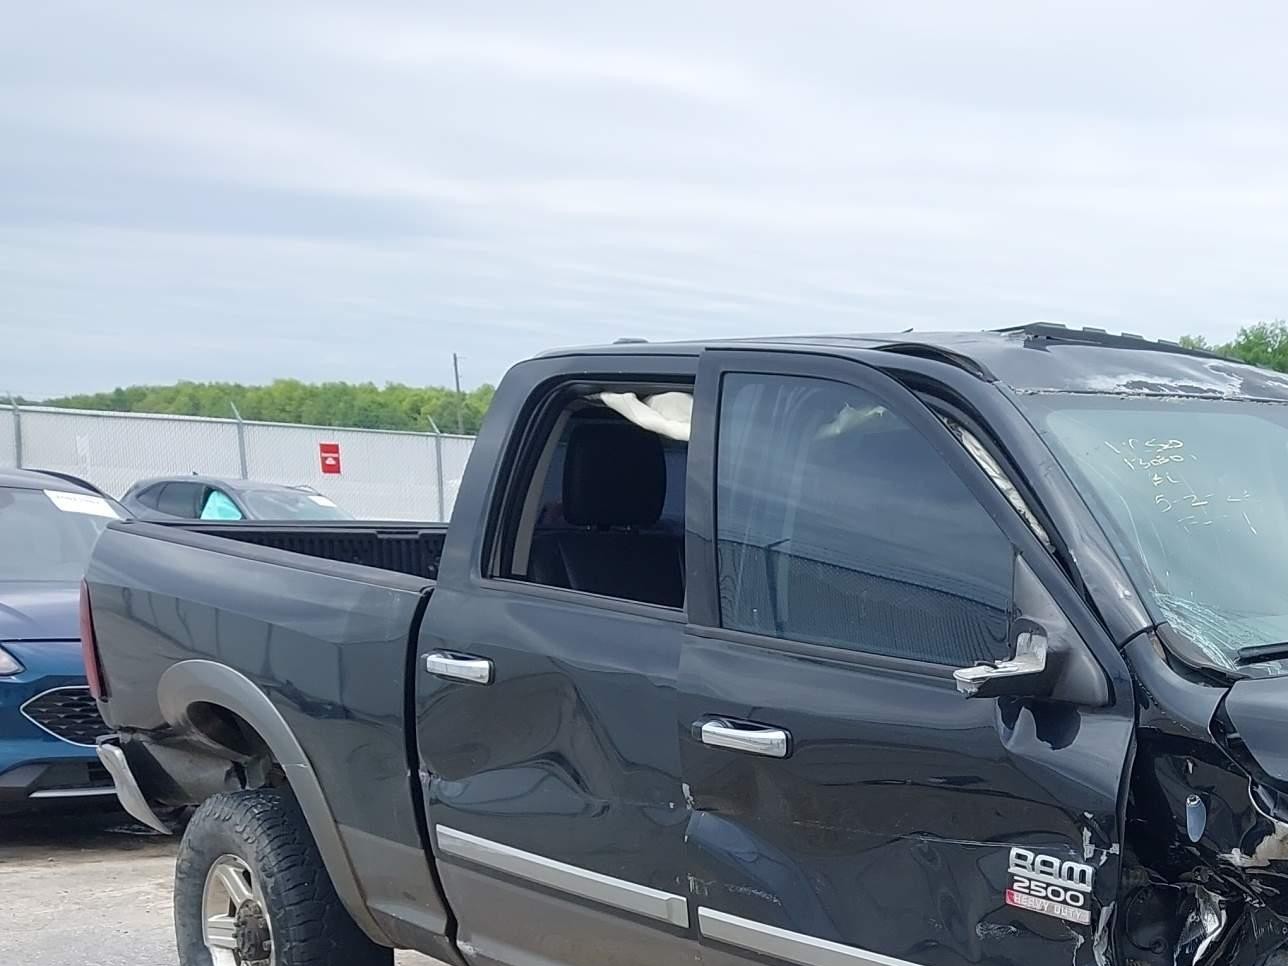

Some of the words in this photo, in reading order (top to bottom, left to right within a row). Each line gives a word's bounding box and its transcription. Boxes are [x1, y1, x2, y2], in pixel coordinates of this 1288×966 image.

[1009, 847, 1093, 889] RAM
[1013, 876, 1084, 907] 2500
[1014, 893, 1049, 912] HEAVY
[1054, 902, 1083, 921] DUTY
